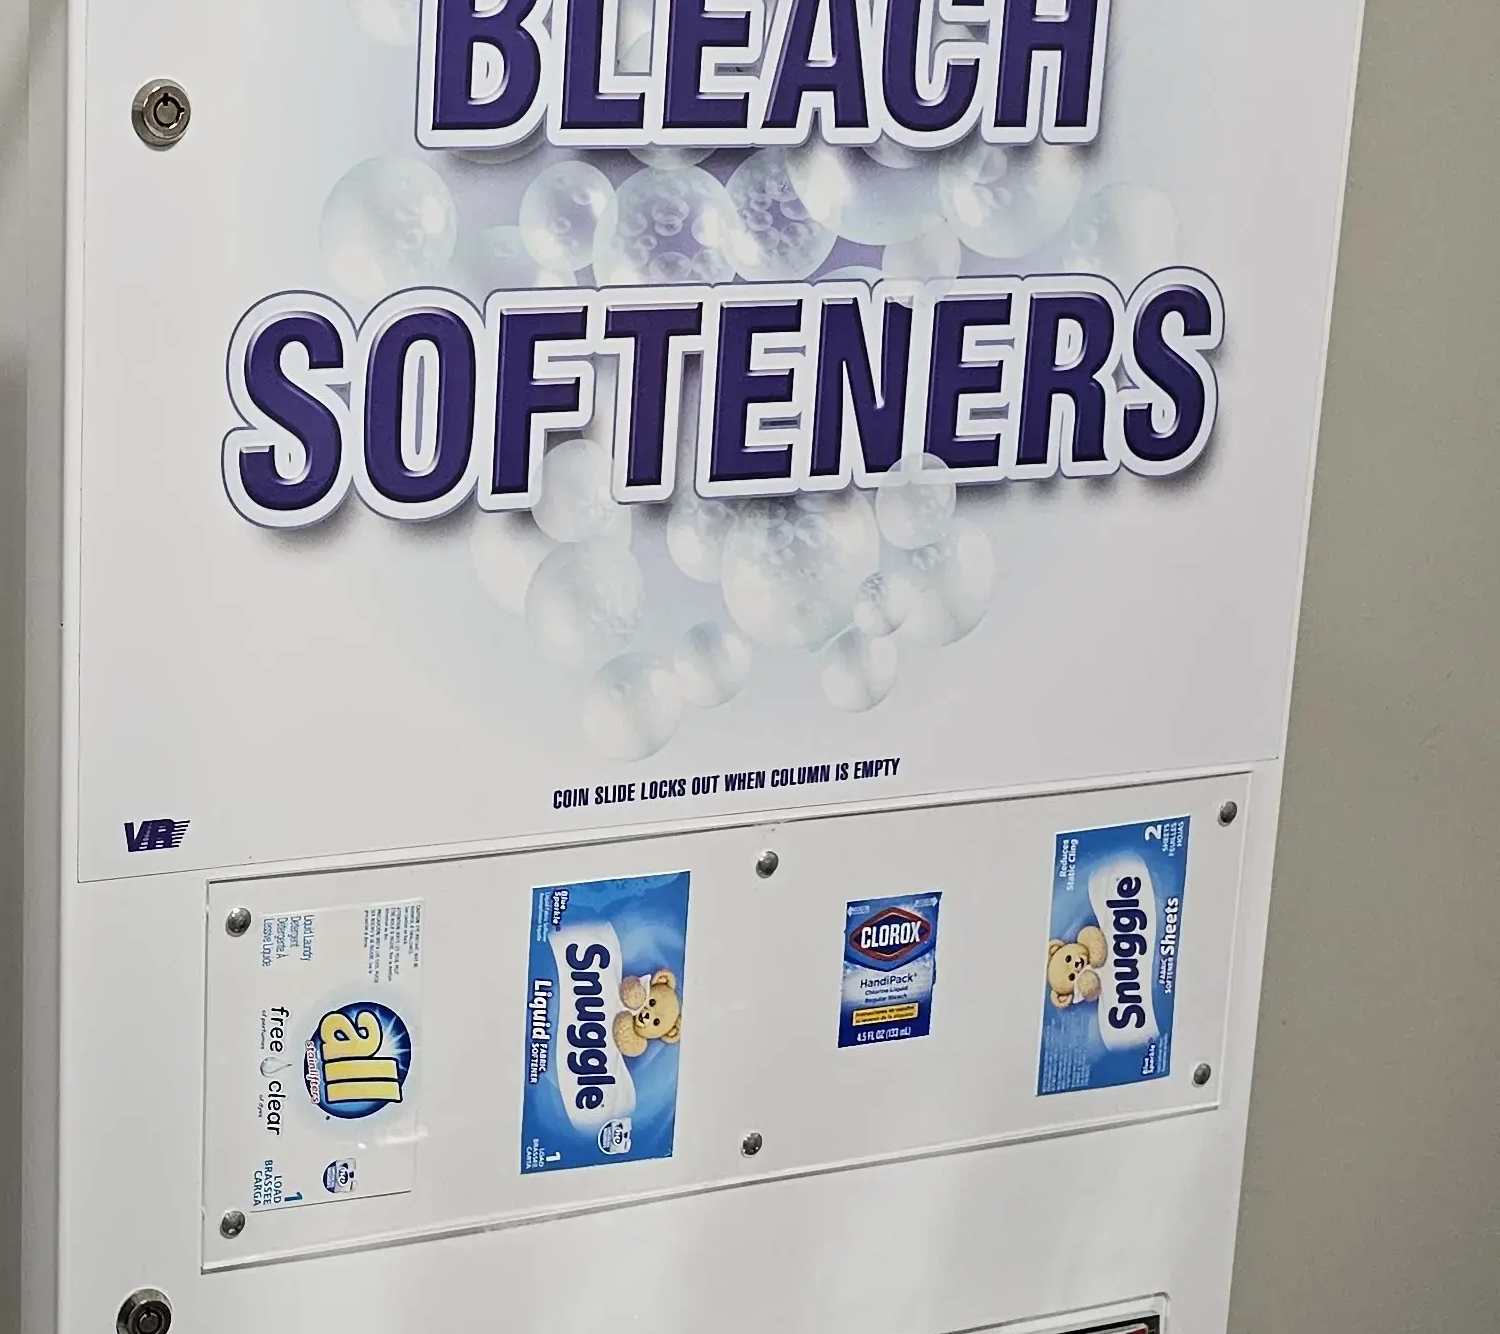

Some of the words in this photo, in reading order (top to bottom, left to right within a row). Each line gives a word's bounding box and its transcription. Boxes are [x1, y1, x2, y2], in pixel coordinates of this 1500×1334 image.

[233, 280, 1216, 512] SOFTENERS
[553, 787, 589, 809] COIN
[594, 783, 636, 805] SLIDE
[640, 778, 687, 800] LOCKS
[691, 775, 720, 795] OUT
[724, 770, 766, 792] WHEN
[770, 764, 831, 787] COLUMN
[835, 762, 849, 781] IS
[853, 758, 901, 779] EMPTY
[1068, 838, 1079, 863] Cling
[1144, 824, 1163, 841] 2
[1059, 839, 1069, 878] Reduces
[1066, 864, 1076, 892] Static
[860, 920, 922, 949] CLOROX
[1161, 898, 1179, 956] Sheets
[1106, 876, 1148, 1030] Snuggle
[269, 1006, 290, 1053] free
[529, 980, 553, 1040] Liquid
[565, 943, 616, 1110] Snuggle
[320, 1009, 403, 1104] all
[868, 1031, 875, 1041] FL
[305, 1040, 320, 1104] stainlifters
[530, 1043, 539, 1084] SOFTENER
[267, 1080, 286, 1136] clear
[546, 1151, 561, 1162] 1
[253, 1170, 263, 1207] CARGA
[273, 1175, 283, 1204] LOAD
[284, 1191, 303, 1202] 1
